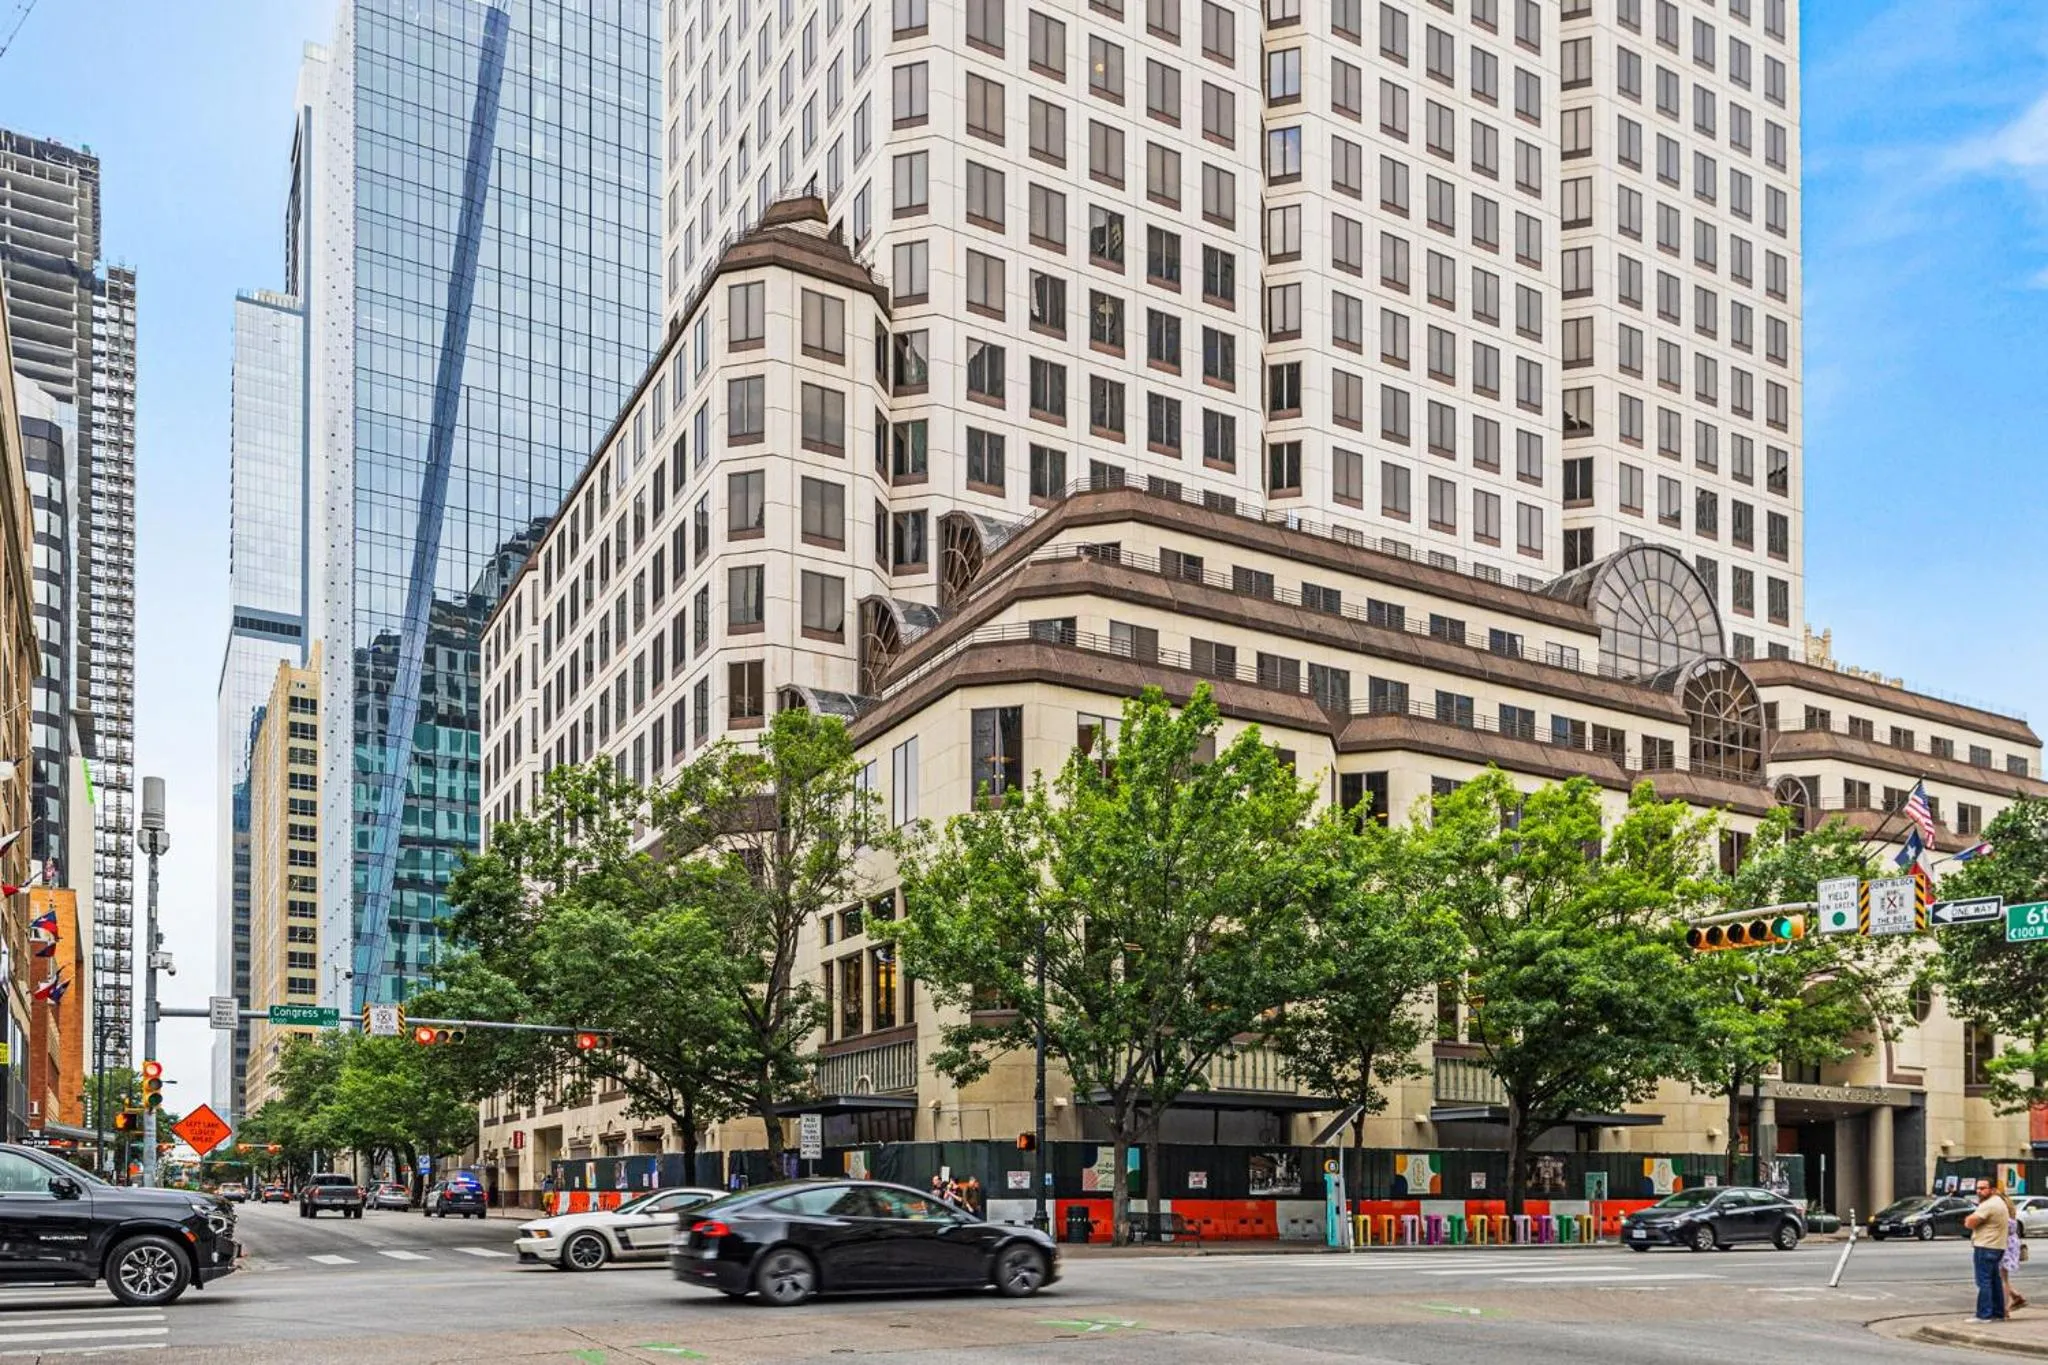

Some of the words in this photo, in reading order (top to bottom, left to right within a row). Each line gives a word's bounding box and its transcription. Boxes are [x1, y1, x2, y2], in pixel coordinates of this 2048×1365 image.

[1828, 890, 1850, 901] YIELD
[1834, 901, 1855, 910] GREEN
[1951, 907, 1969, 916] ONE
[1973, 904, 1993, 914] WAY
[273, 1006, 319, 1019] Congress
